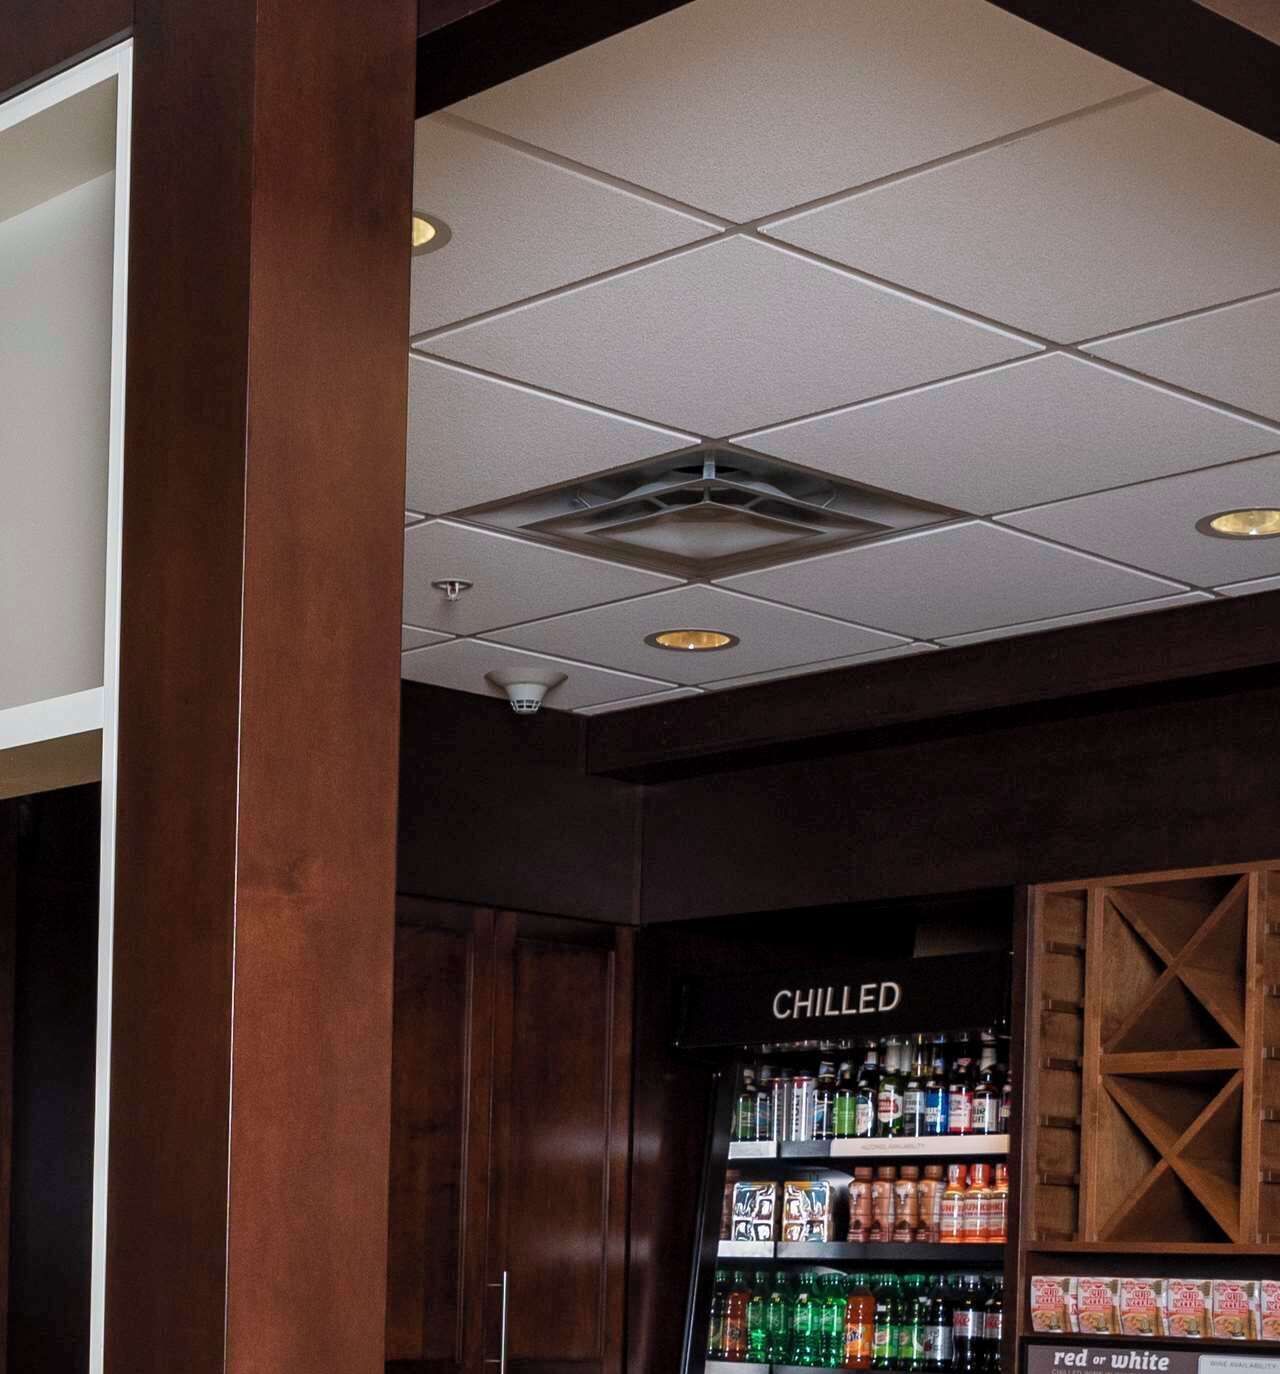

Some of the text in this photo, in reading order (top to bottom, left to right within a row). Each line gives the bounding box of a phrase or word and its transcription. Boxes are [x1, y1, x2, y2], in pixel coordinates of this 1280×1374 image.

[772, 981, 902, 1021] CHILLED
[1053, 1348, 1169, 1371] red or white
